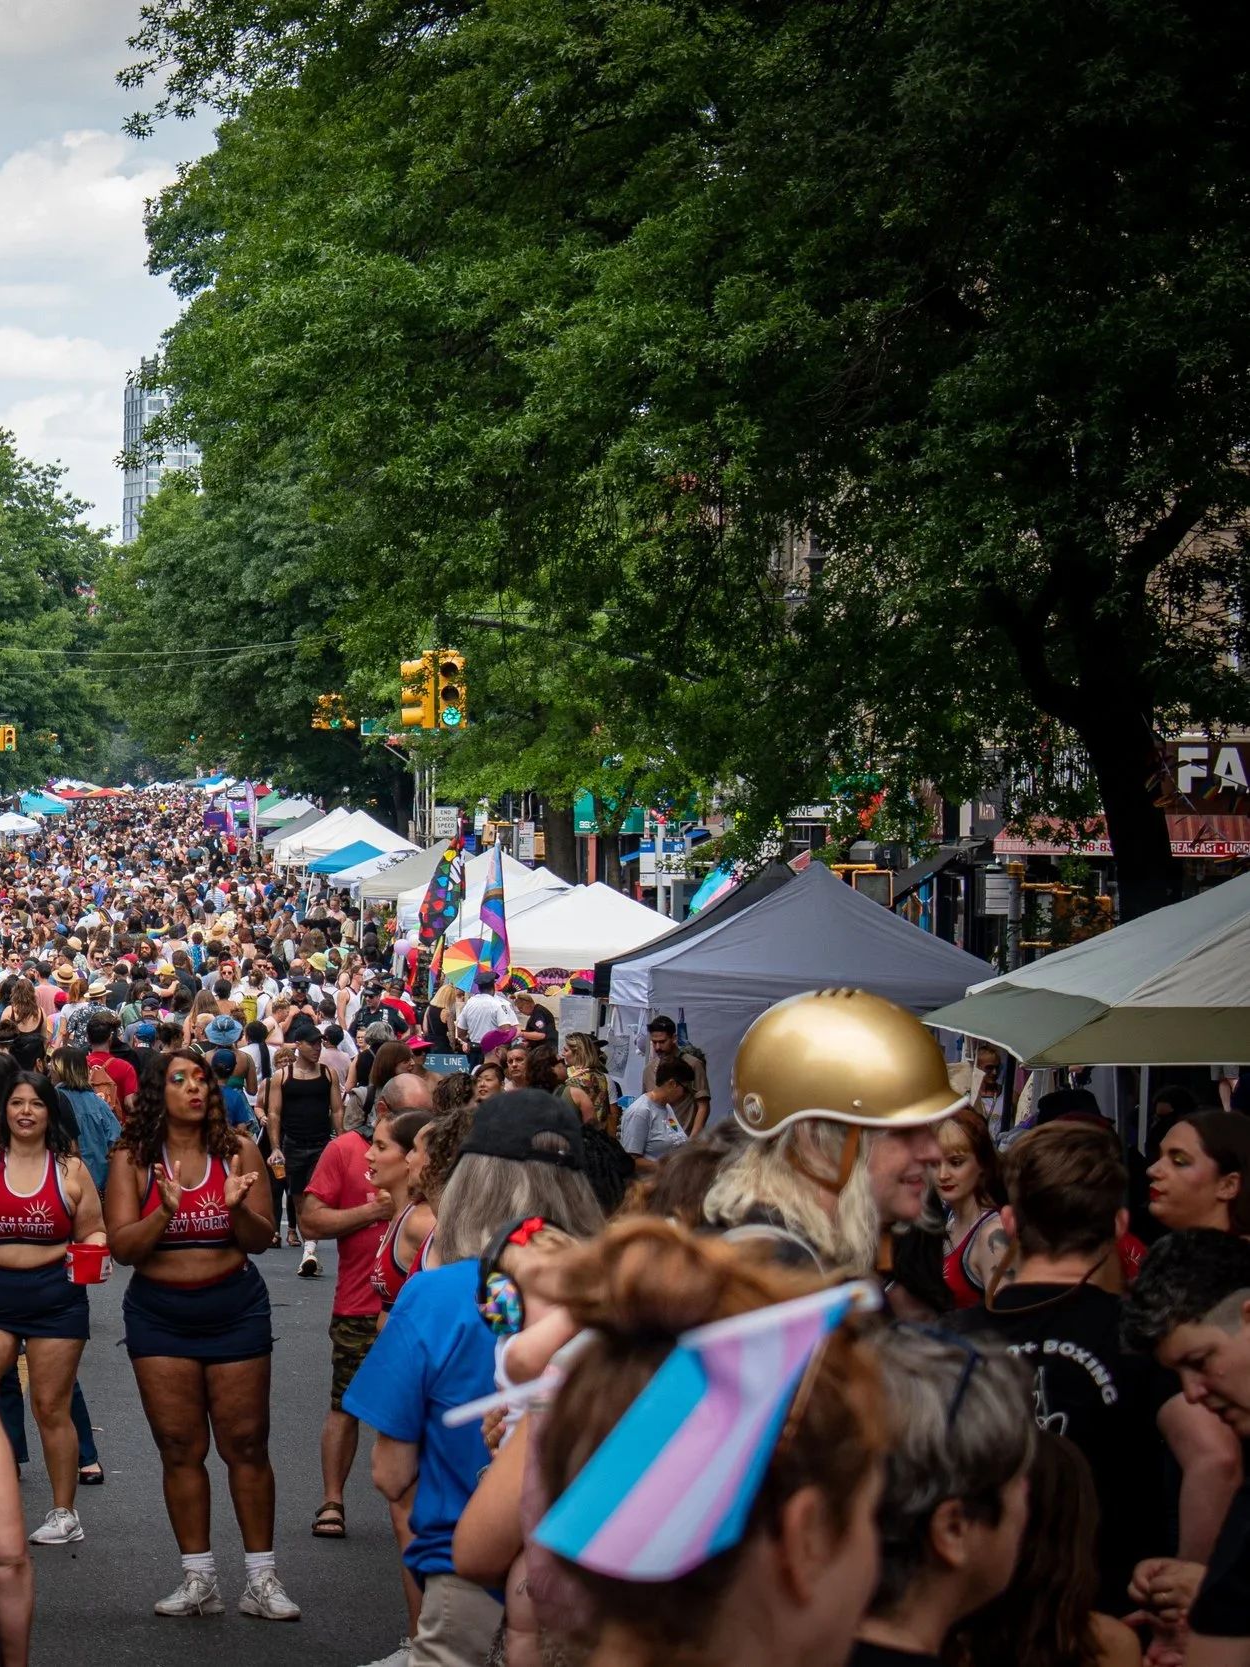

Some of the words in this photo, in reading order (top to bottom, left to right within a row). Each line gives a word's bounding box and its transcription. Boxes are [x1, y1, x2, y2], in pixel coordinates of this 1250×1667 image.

[1170, 843, 1217, 853] REAKFAST
[443, 1057, 463, 1066] LINE
[0, 1215, 41, 1223] CHEER
[165, 1220, 190, 1234] EW
[191, 1214, 230, 1232] YORK
[18, 1223, 54, 1235] YORK
[1043, 1339, 1119, 1405] BOXING
